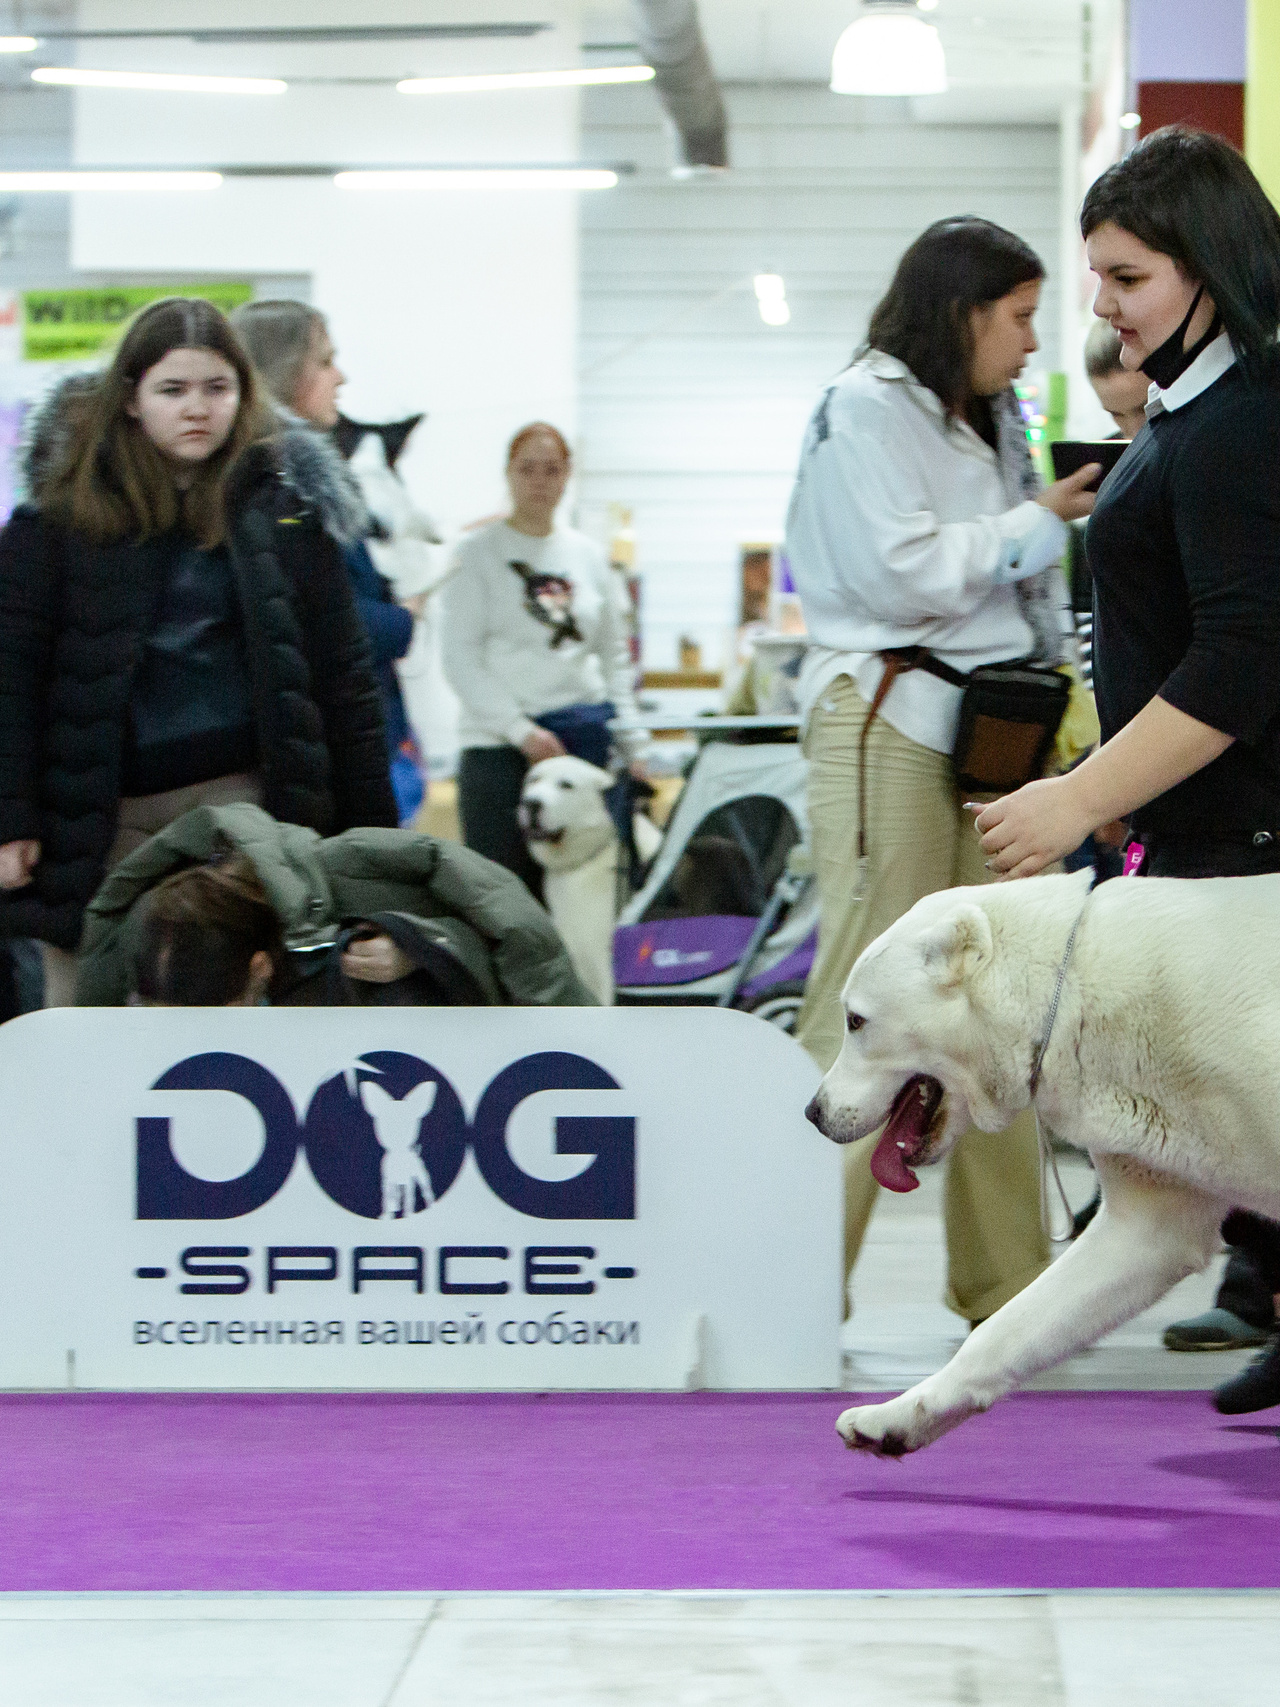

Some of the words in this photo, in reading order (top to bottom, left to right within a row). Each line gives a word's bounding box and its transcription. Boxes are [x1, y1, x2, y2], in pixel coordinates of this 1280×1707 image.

[135, 1050, 637, 1220] DOG
[134, 1320, 345, 1345] вселенная
[357, 1312, 487, 1345] вашей
[496, 1311, 641, 1345] собаки
